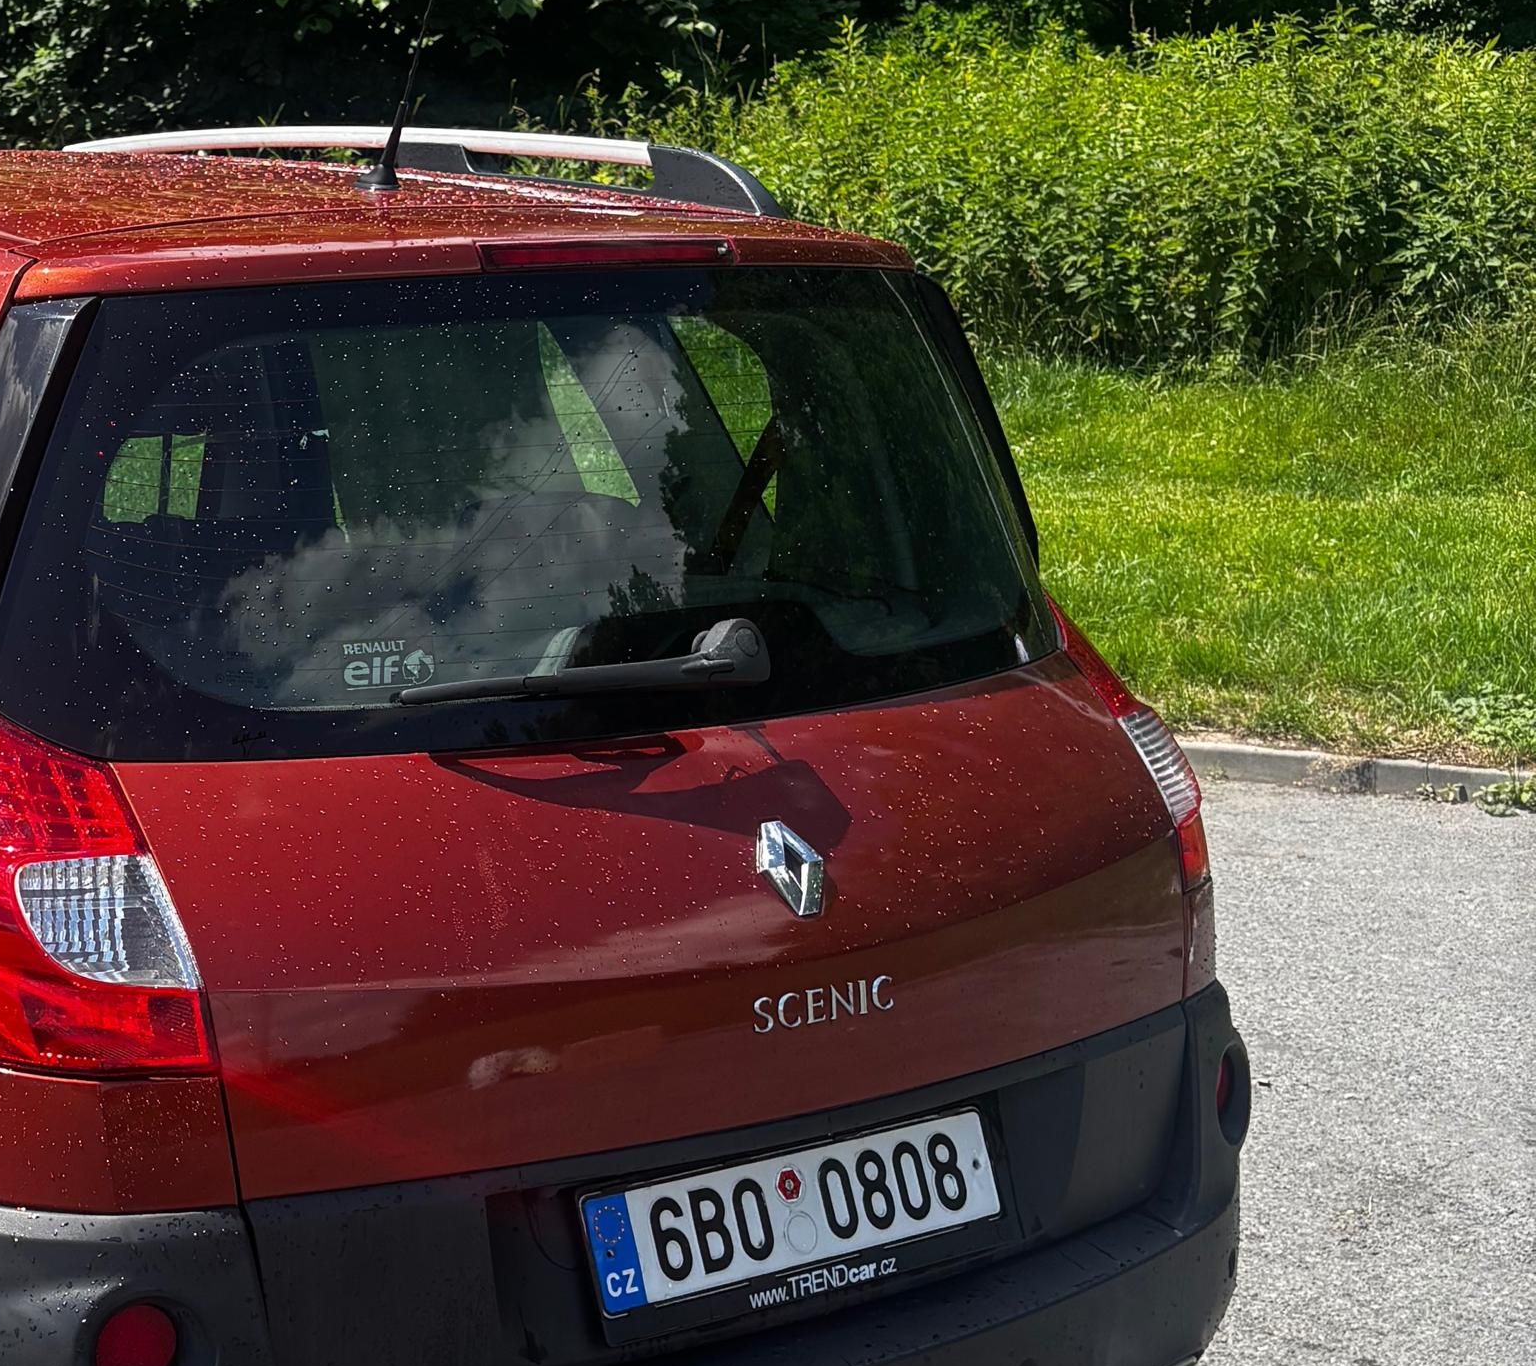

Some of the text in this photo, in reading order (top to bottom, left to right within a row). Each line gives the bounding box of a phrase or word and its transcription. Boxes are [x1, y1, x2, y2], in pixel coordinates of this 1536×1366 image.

[343, 640, 406, 655] RENAULT
[343, 654, 401, 686] elf
[753, 975, 895, 1034] SCENIC
[648, 1132, 969, 1283] 6B0 0808
[606, 1267, 639, 1298] CZ
